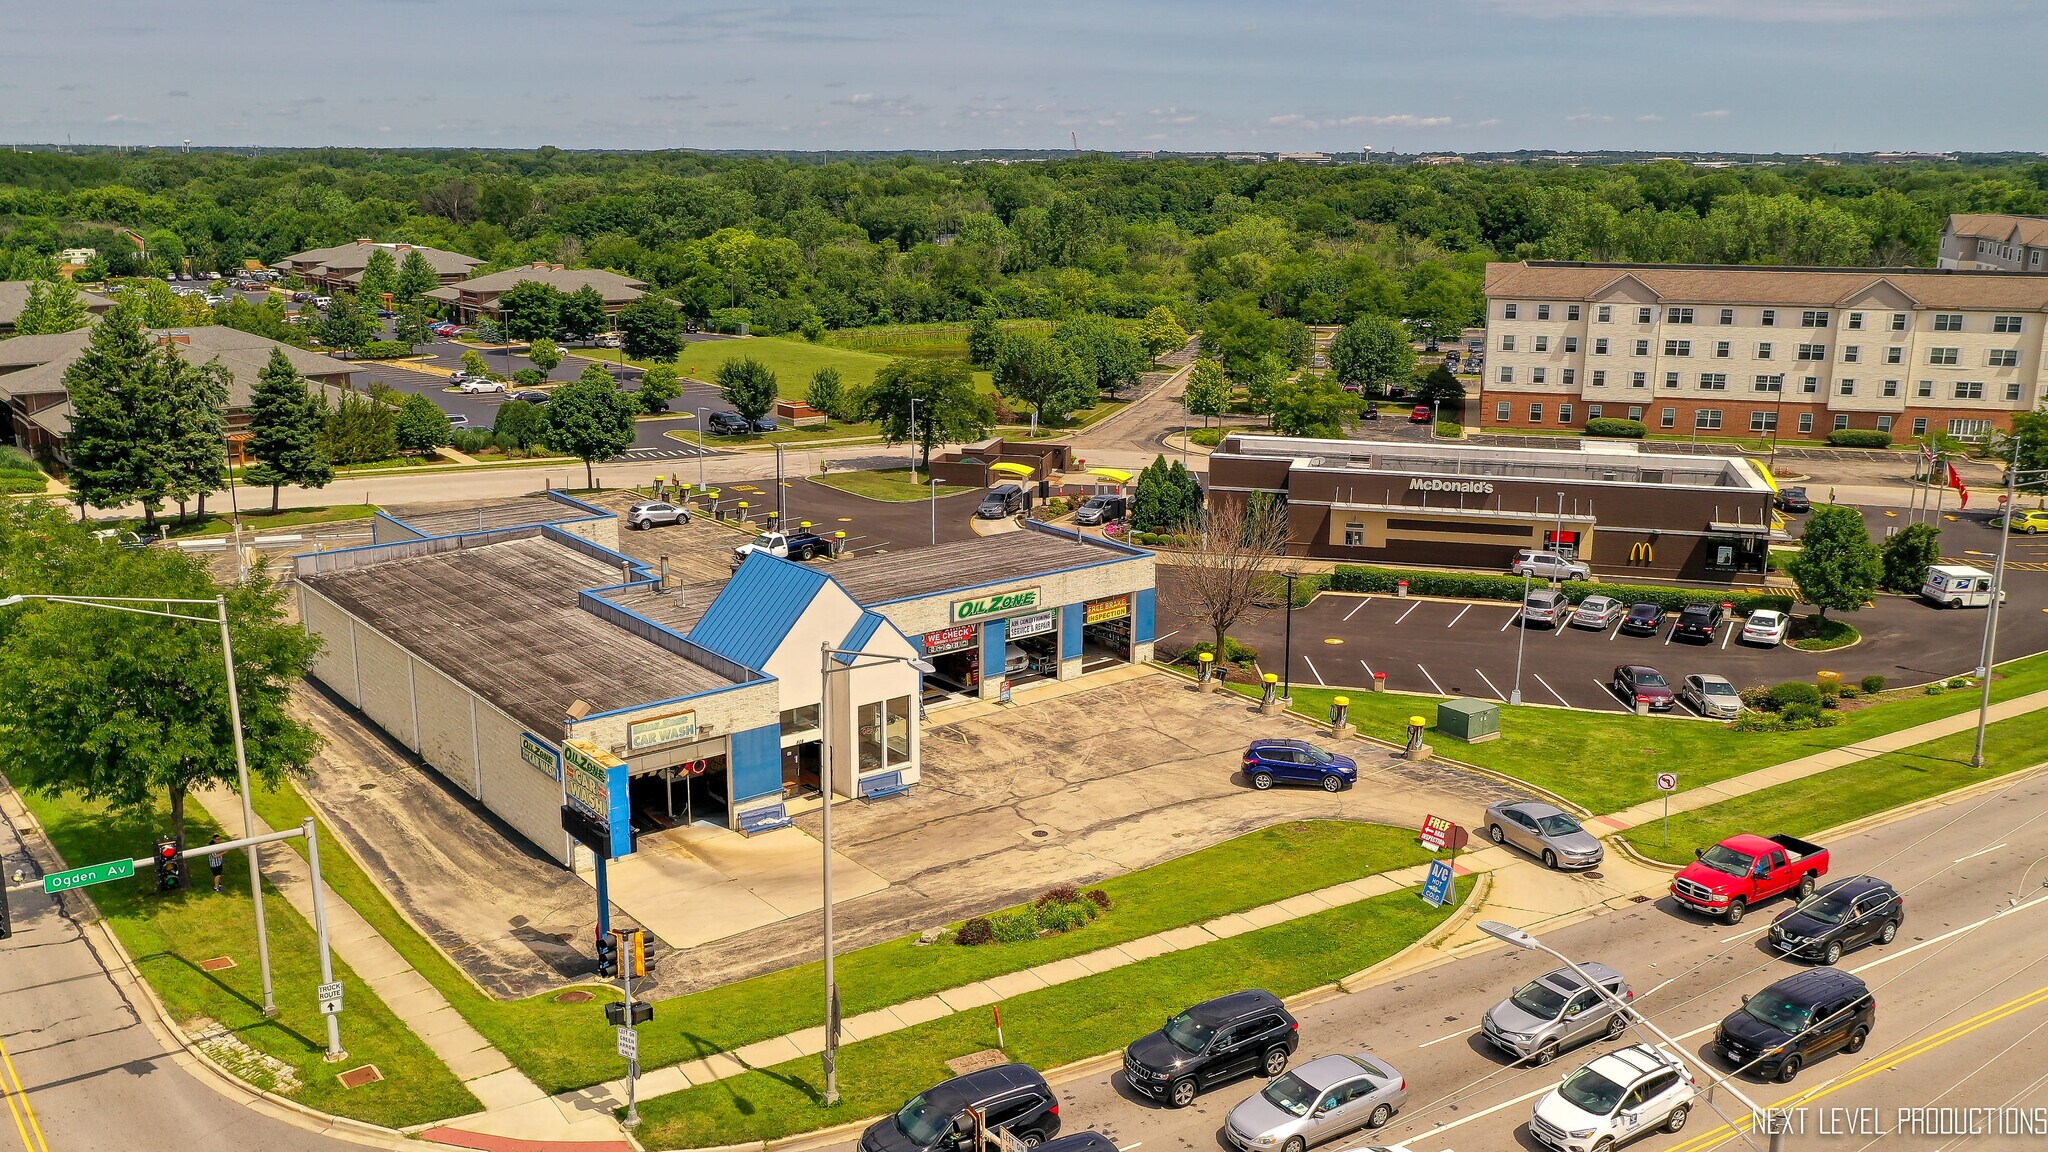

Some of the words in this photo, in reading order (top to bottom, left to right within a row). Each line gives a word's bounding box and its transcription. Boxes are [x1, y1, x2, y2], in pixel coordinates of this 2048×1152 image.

[1409, 478, 1494, 494] McDonald's
[1088, 608, 1126, 622] INSPECTION
[928, 633, 941, 642] WE
[942, 628, 969, 640] CHECK
[633, 732, 657, 747] CAR
[659, 724, 694, 741] WASH
[575, 769, 597, 794] CAR
[1428, 816, 1451, 832] FREE
[52, 871, 97, 887] Ogden
[107, 865, 126, 877] Av
[1431, 863, 1449, 882] A/C
[1432, 877, 1443, 887] HOT
[1425, 890, 1440, 901] COLD
[319, 983, 341, 993] TRUCK
[319, 989, 341, 999] ROUTE
[620, 1035, 635, 1045] GREEN
[1002, 1131, 1014, 1147] LEFT
